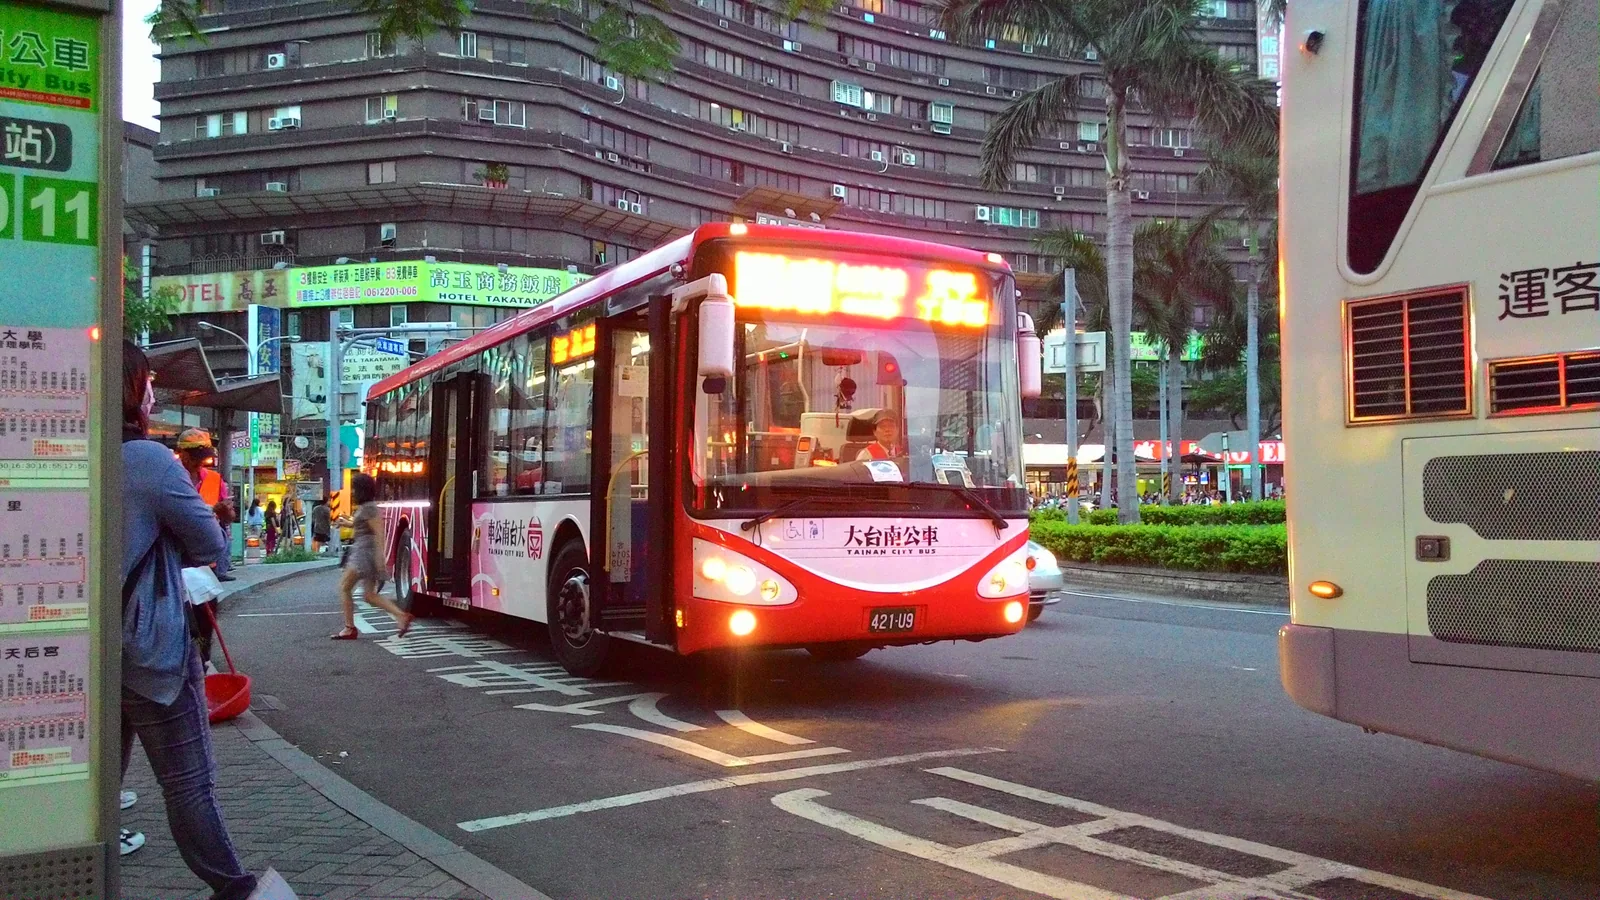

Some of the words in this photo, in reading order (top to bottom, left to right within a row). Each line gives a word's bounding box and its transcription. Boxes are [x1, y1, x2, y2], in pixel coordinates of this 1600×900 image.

[0, 30, 90, 72] 公車
[45, 74, 91, 94] Bus
[30, 186, 89, 240] 11
[363, 286, 417, 297] (06)2201-006
[429, 268, 561, 295] 高玉商務飯店
[439, 292, 479, 302] HOTEL
[843, 525, 939, 547] 大台南公車
[871, 612, 914, 630] 421-U9
[5, 646, 60, 660] 天后宮
